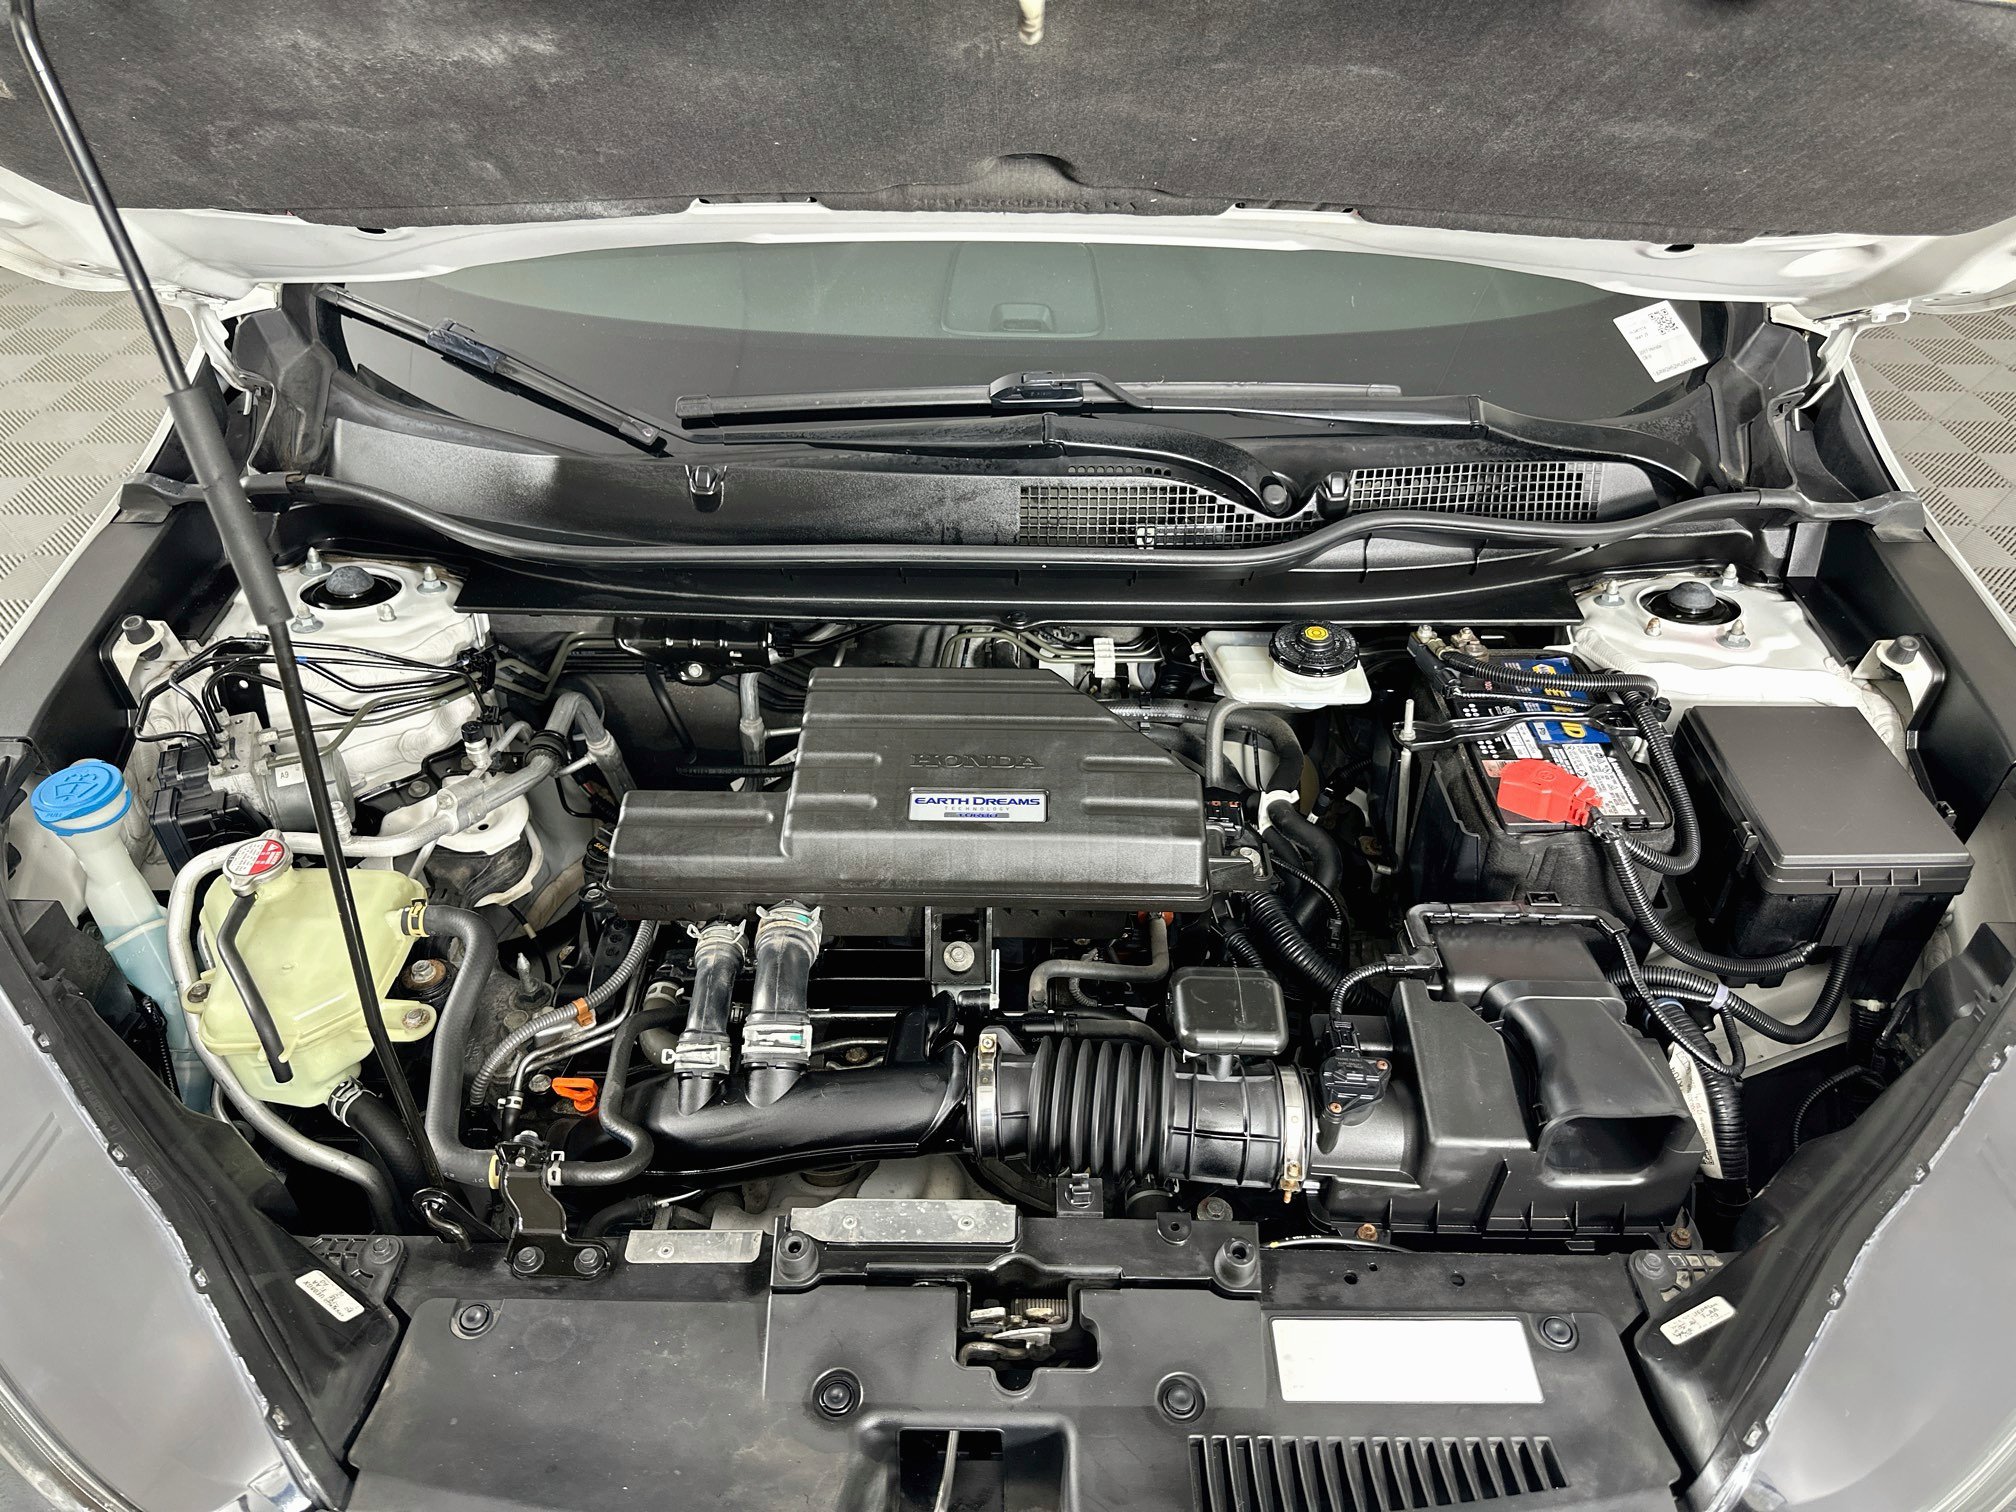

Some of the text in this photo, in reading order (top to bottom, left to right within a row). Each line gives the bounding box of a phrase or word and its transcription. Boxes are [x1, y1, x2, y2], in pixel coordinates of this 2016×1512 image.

[909, 753, 1045, 769] HONDA
[914, 796, 1040, 806] EARTH DREAMS
